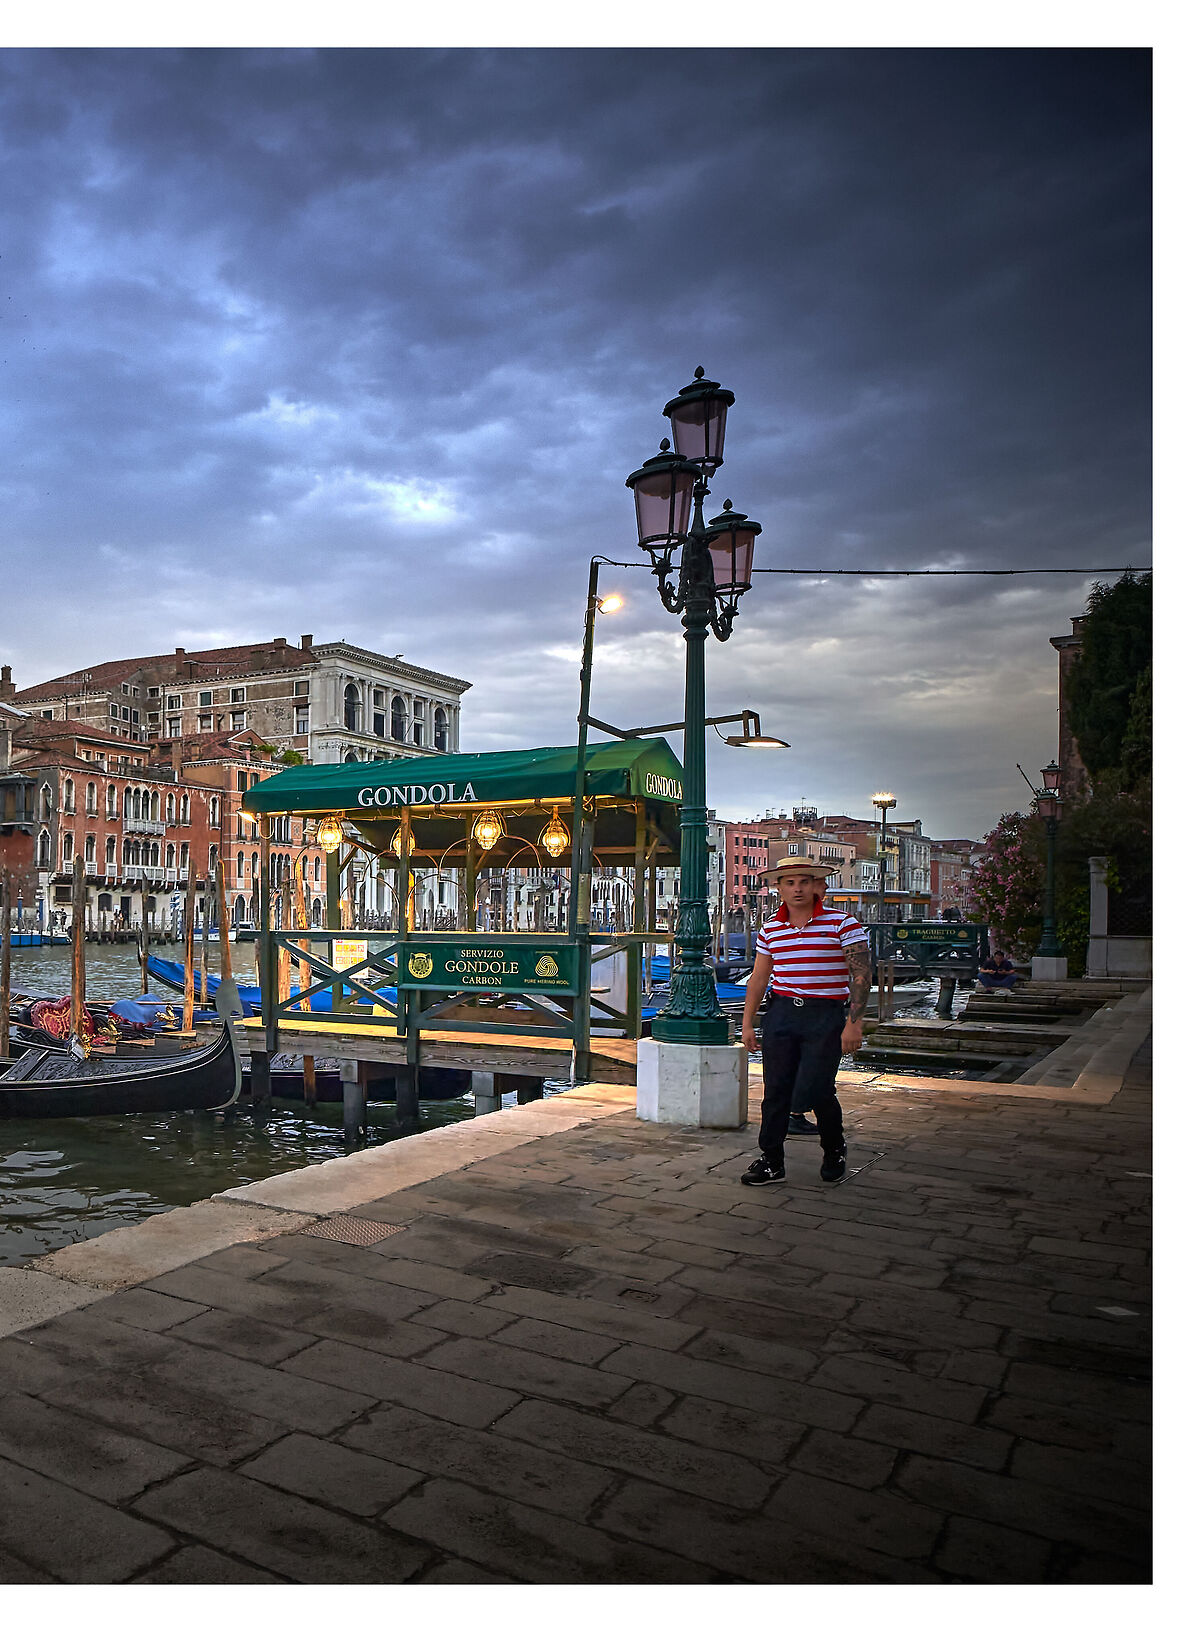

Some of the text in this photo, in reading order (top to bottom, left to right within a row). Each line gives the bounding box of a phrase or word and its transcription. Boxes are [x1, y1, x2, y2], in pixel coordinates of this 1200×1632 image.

[646, 772, 683, 800] GONDOLA
[357, 781, 479, 807] GONDOLA
[460, 950, 504, 959] SERVIZIO
[445, 960, 519, 974] GONDOLE
[461, 975, 502, 985] CARBON
